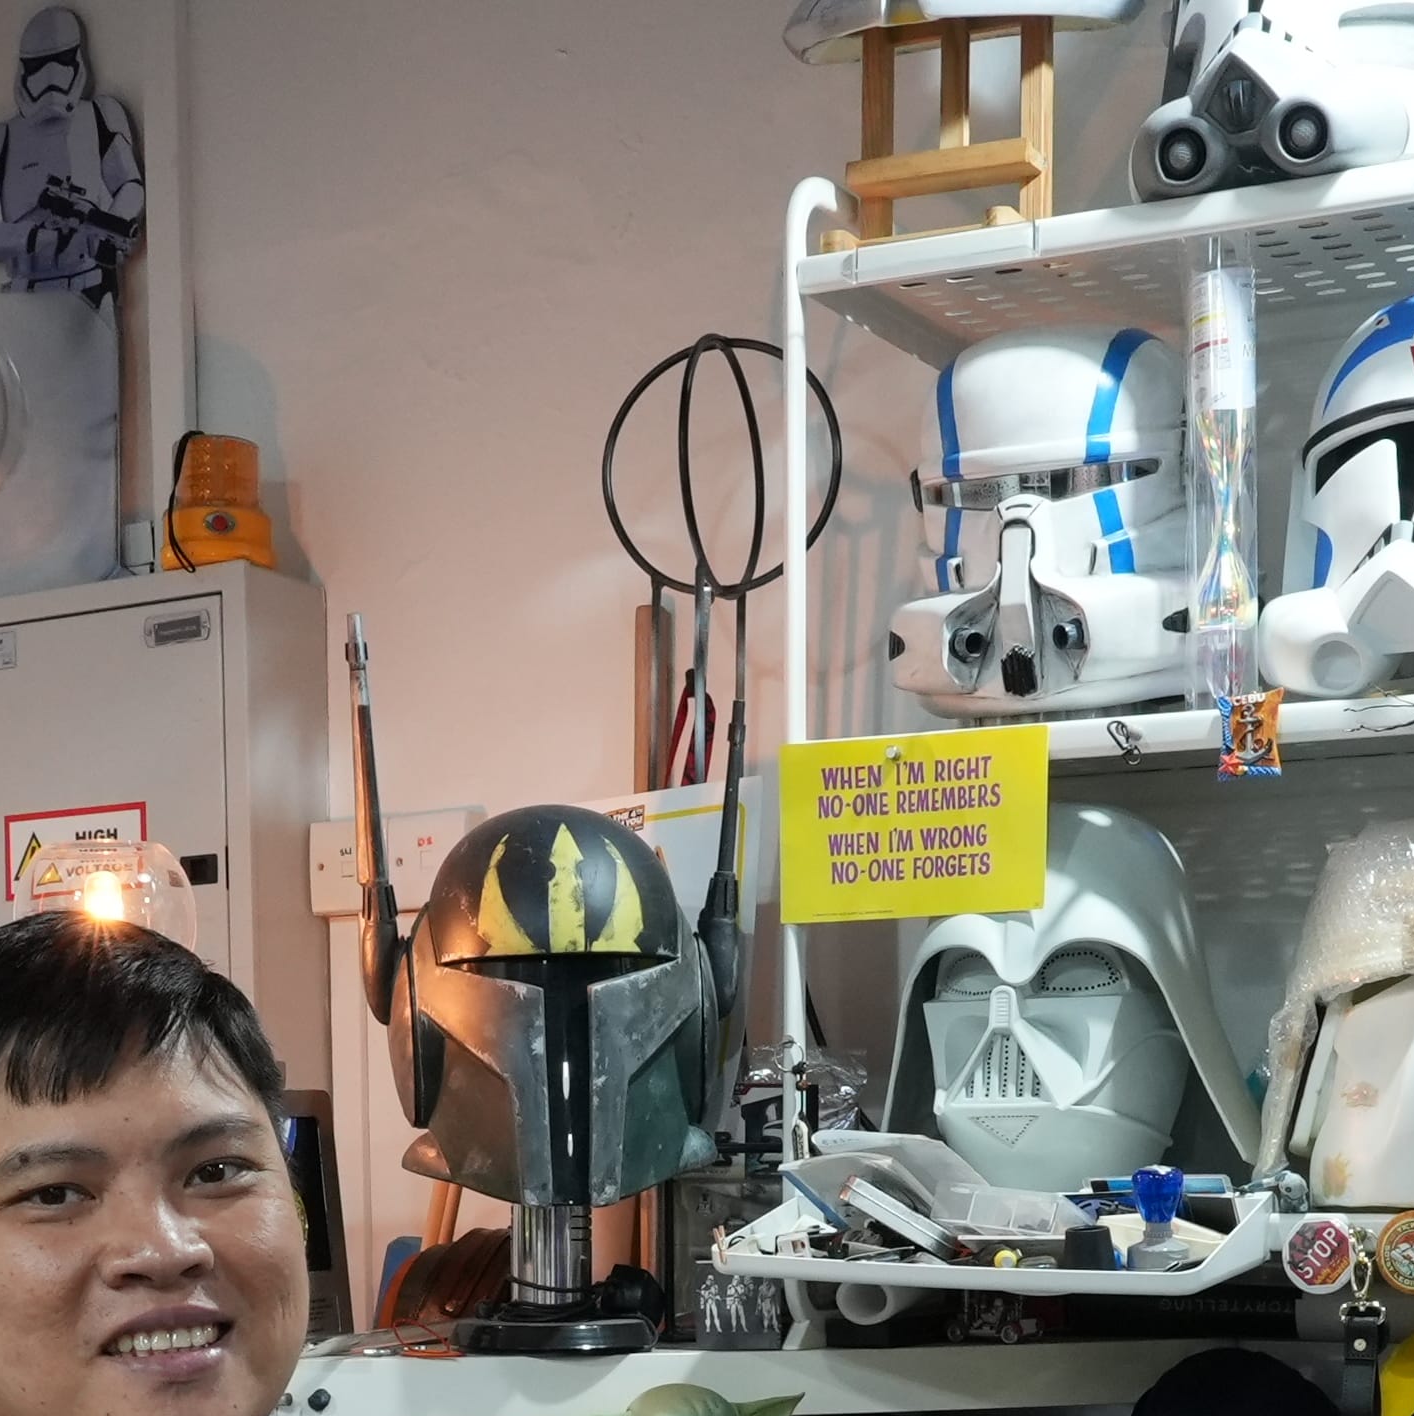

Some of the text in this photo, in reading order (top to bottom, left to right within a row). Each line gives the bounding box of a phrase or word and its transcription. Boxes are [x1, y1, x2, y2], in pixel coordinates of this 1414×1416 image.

[1232, 692, 1266, 707] CEBU
[821, 755, 993, 791] WHEN I'M RIGHT
[818, 783, 1001, 819] NO-ONE REMEMBERS
[75, 828, 118, 841] HIGH
[828, 824, 988, 856] WHEN I'M WRONG
[66, 863, 134, 877] VOLTAGE
[831, 852, 991, 885] NO-ONE FORGETS
[1298, 1227, 1339, 1280] STOP
